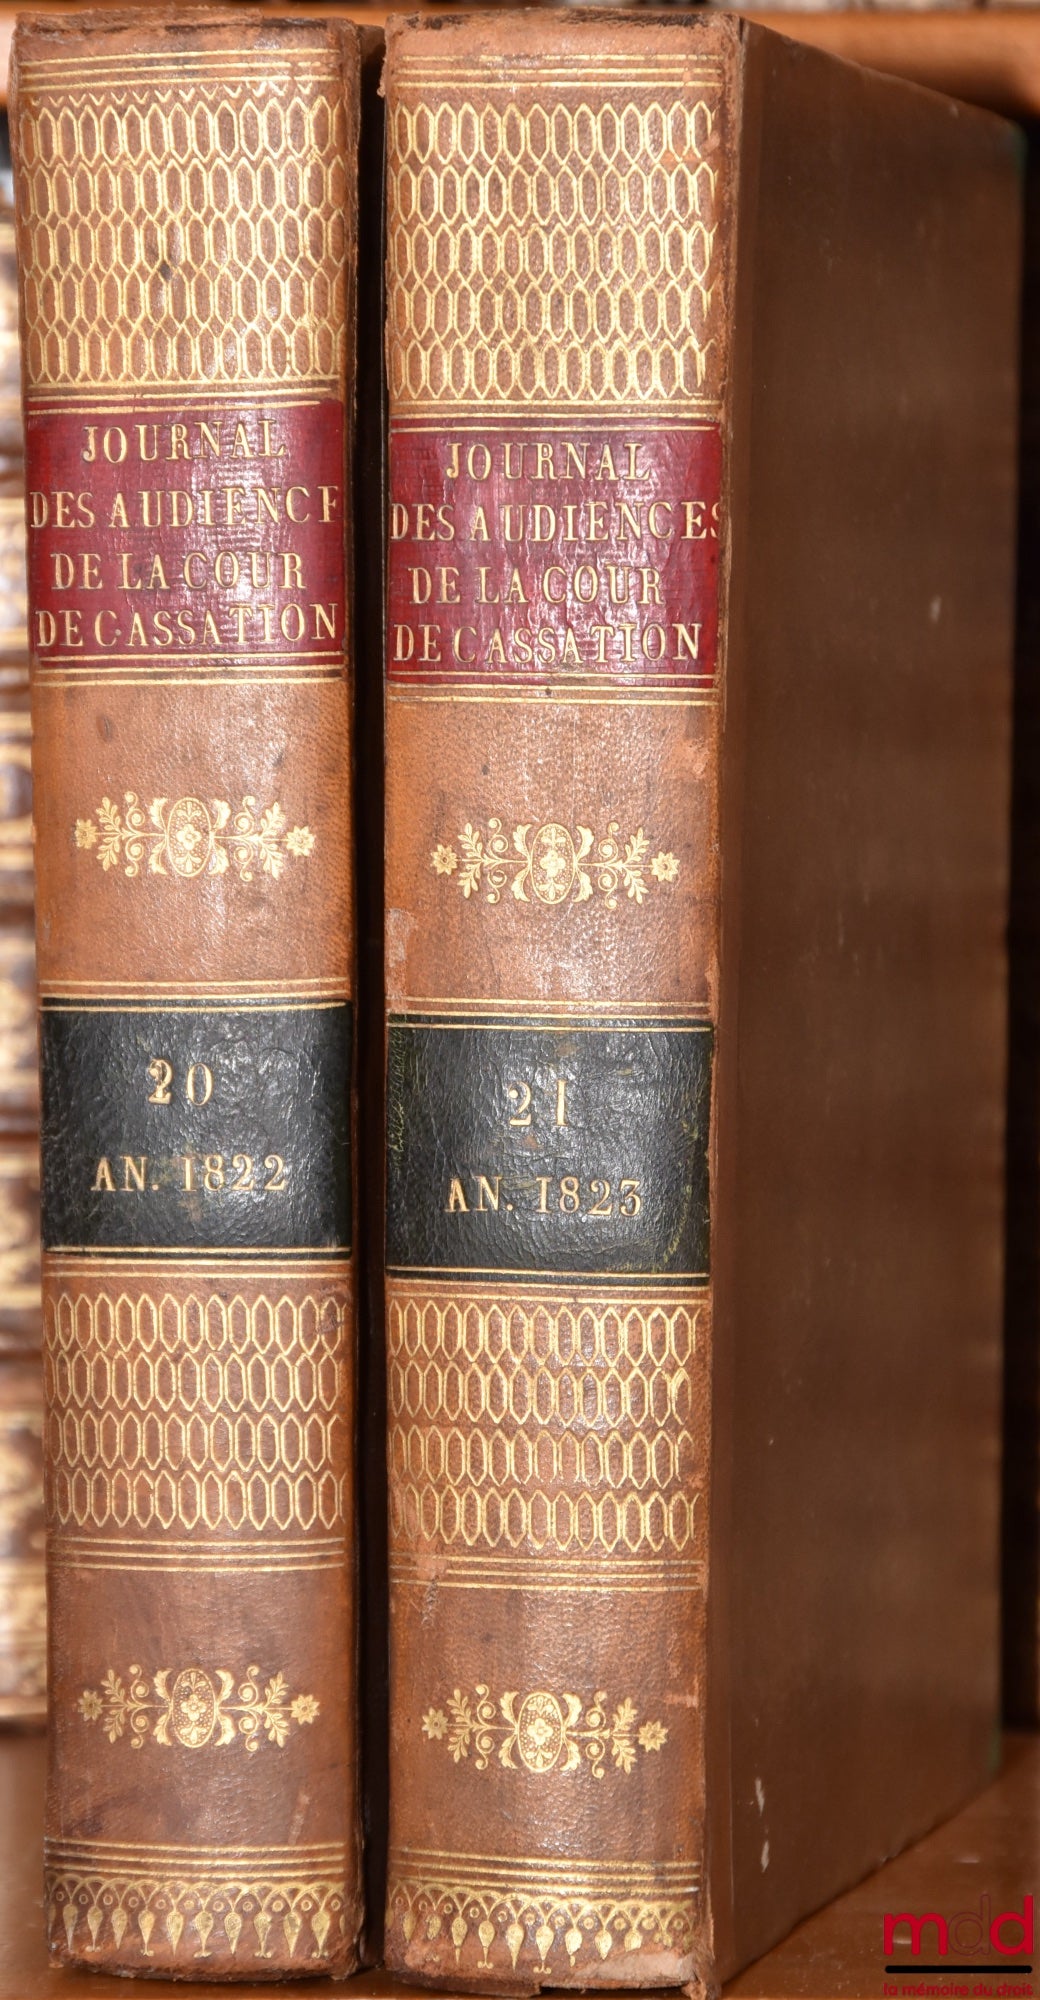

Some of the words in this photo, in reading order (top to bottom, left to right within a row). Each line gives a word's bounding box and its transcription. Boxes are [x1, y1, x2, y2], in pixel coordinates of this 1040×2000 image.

[82, 419, 287, 464] JOURNAL
[445, 441, 652, 482] JOURNAL
[30, 490, 96, 529] DES
[390, 502, 456, 542] DES
[50, 552, 104, 591] DE
[116, 552, 171, 591] LA
[183, 551, 307, 590] COUR
[407, 566, 461, 605] DE
[474, 565, 530, 605] LA
[542, 563, 664, 606] COUR
[35, 609, 84, 648] DE
[393, 623, 442, 662] DE
[452, 621, 702, 665] CASSATION
[147, 1057, 215, 1107] 20
[507, 1078, 570, 1128] 21
[90, 1155, 161, 1193] AN.
[180, 1153, 289, 1192] 1822
[443, 1175, 515, 1213] AN.
[534, 1175, 643, 1218] 1823
